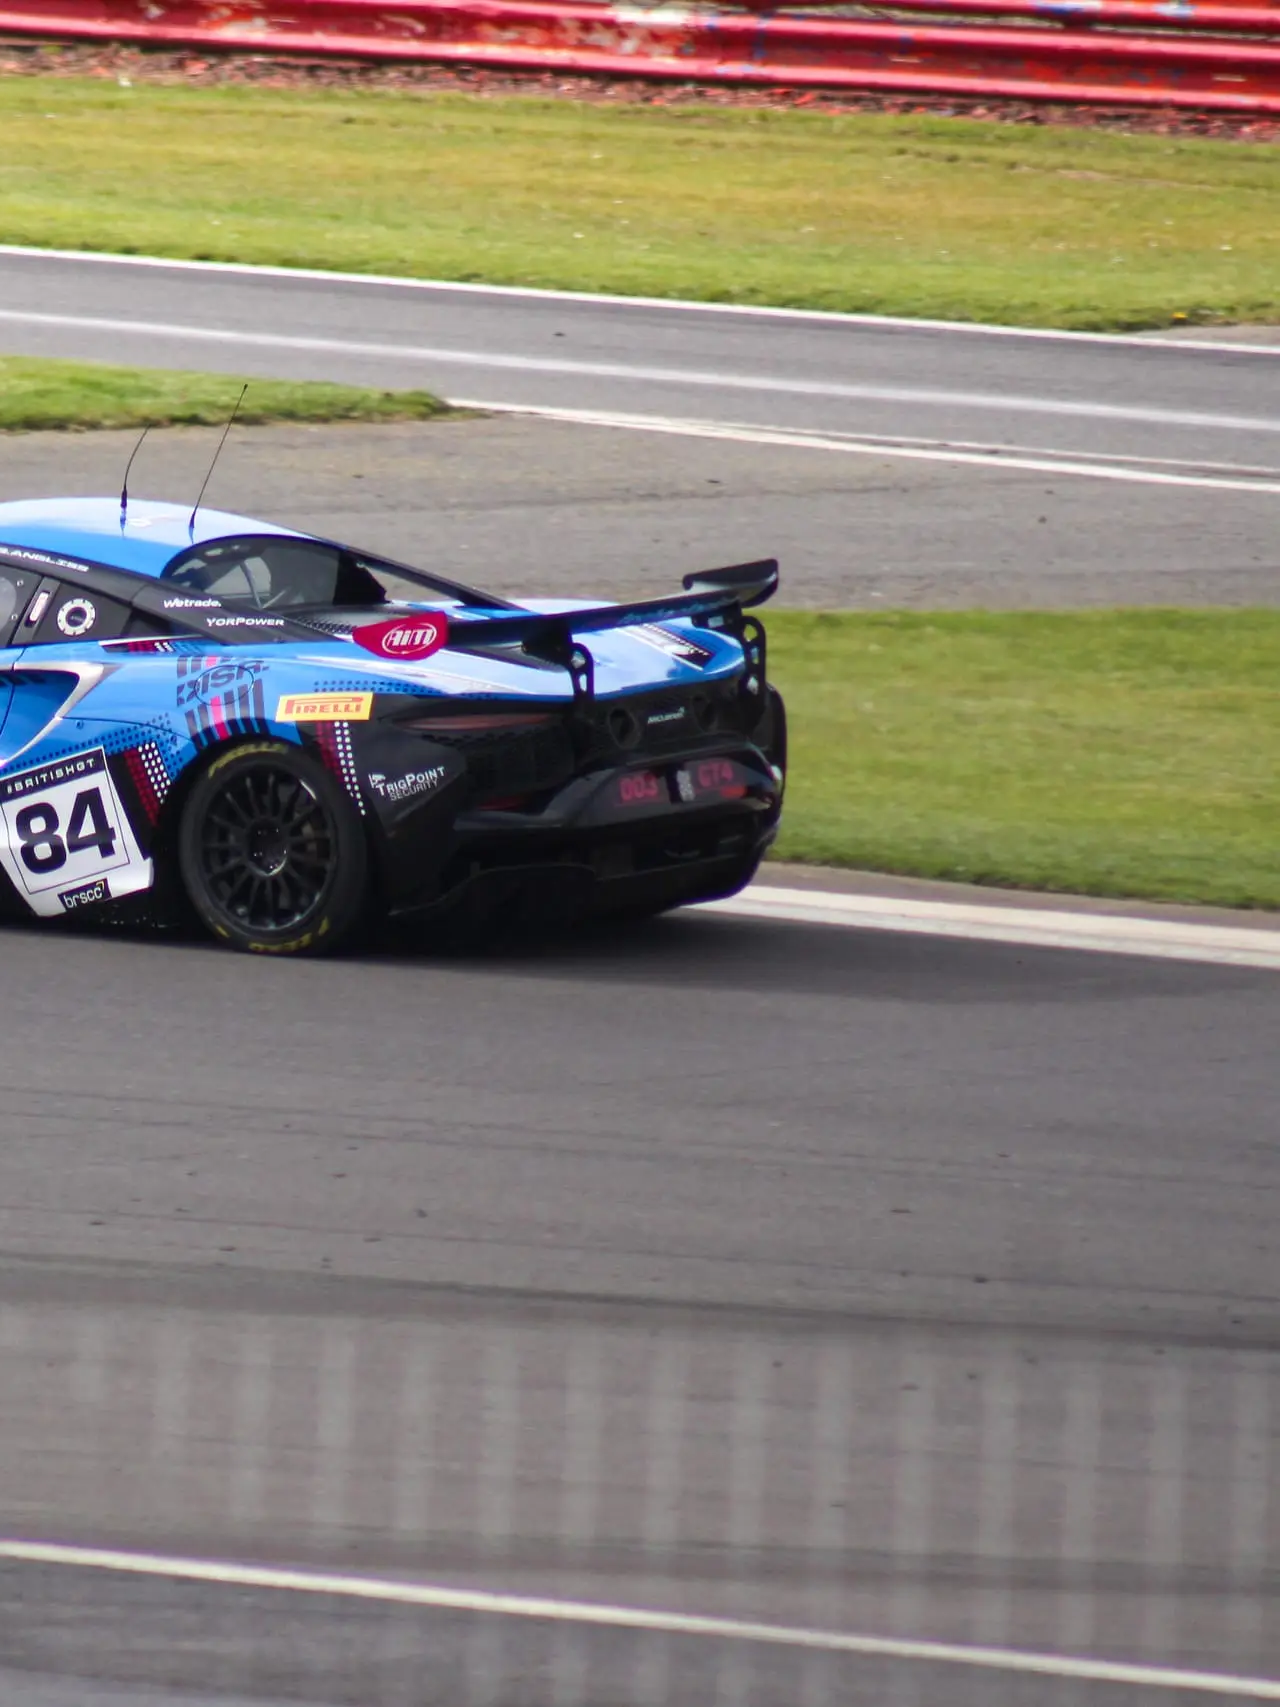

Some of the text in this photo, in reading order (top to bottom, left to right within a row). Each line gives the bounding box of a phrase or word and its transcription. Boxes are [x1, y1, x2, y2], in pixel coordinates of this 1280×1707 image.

[206, 617, 285, 626] YORPOWER
[284, 696, 364, 714] PIRELLI
[389, 778, 438, 801] SECURITY
[15, 786, 117, 875] 84
